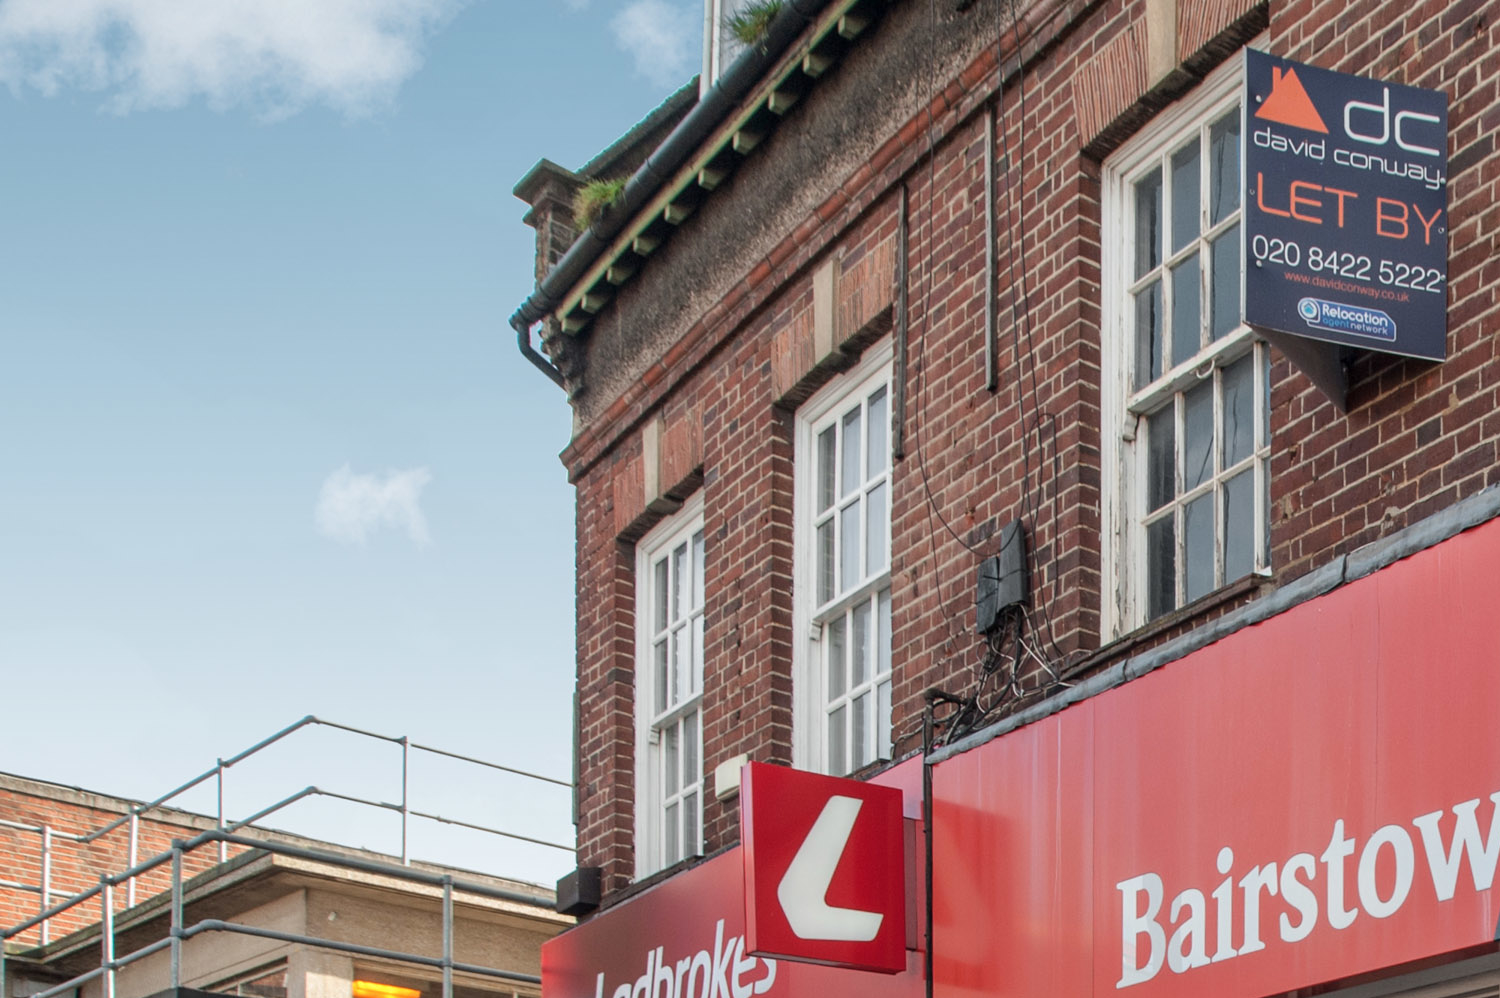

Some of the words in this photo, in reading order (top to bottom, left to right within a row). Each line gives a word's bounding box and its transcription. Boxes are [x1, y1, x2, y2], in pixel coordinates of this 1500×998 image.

[1344, 87, 1440, 156] dc
[1254, 127, 1325, 160] david
[1334, 149, 1441, 190] conway
[1257, 172, 1358, 228] LET
[1376, 197, 1442, 245] BY
[1252, 234, 1300, 266] 020
[1308, 247, 1371, 281] 8422
[1379, 261, 1441, 293] 5222
[1284, 270, 1410, 303] www.davidconway.co.uk
[1322, 304, 1389, 328] Relocation
